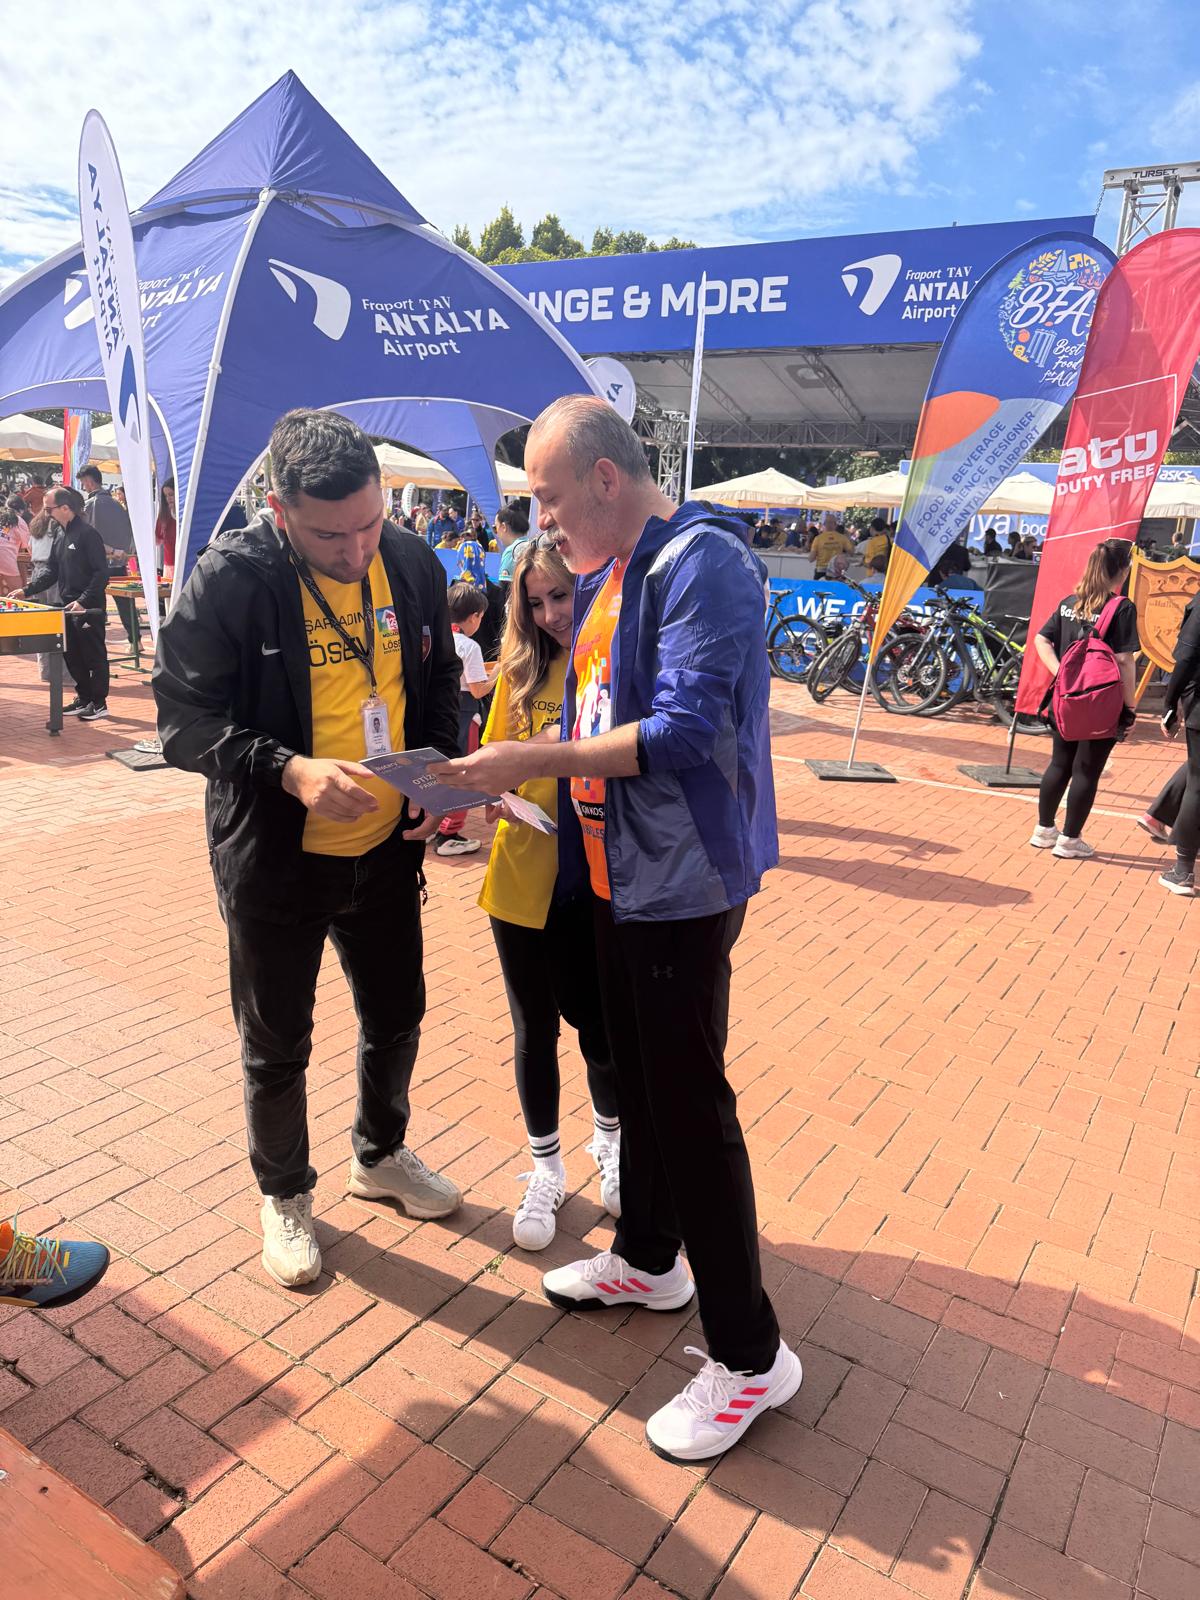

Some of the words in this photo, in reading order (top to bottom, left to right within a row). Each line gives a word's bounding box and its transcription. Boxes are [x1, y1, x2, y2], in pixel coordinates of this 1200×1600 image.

[1132, 168, 1179, 178] TURSET
[905, 269, 942, 282] Fraport
[947, 266, 972, 278] TAV
[140, 271, 224, 312] NTALYA
[623, 286, 651, 319] &
[661, 275, 789, 317] MORE
[903, 281, 969, 302] ANTAL
[362, 298, 414, 313] Fraport
[419, 296, 451, 311] TAV
[901, 304, 957, 322] Airport
[375, 308, 510, 336] ANTALYA
[383, 339, 461, 360] Airport
[1053, 339, 1086, 355] Best
[1052, 355, 1084, 370] Food
[917, 495, 945, 529] FOOD
[944, 485, 955, 495] &
[952, 421, 1006, 484] BEVERAGE
[928, 465, 988, 537] EXPERIENCE
[986, 411, 1036, 466] DESIGNER
[940, 527, 954, 545] OF
[954, 475, 1000, 527] ANTALYA
[998, 426, 1040, 475] AIRPORT
[1056, 474, 1105, 496] DUTY
[1111, 463, 1155, 485] FREE
[797, 596, 846, 622] WE
